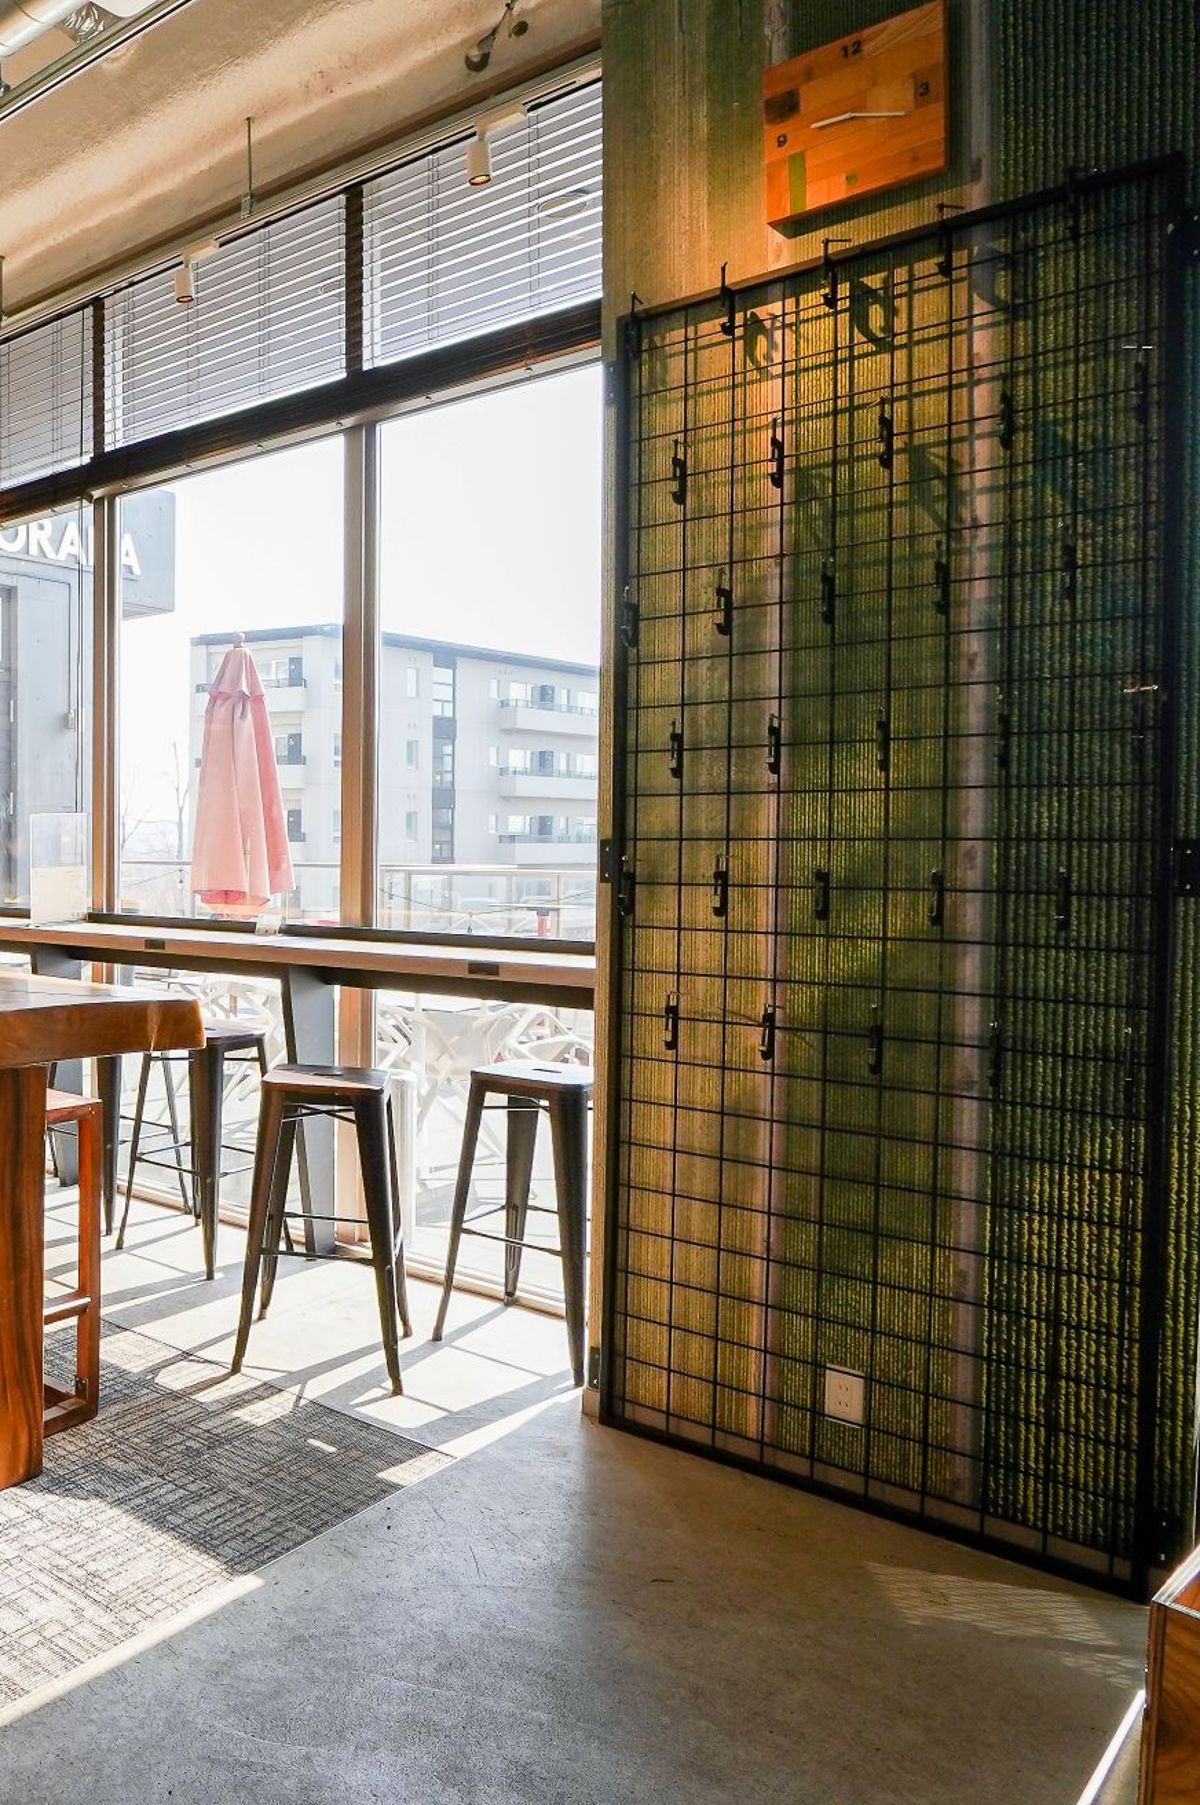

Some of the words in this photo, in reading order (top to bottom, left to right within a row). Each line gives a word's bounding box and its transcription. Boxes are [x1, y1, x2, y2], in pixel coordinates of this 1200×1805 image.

[842, 39, 862, 59] 12
[919, 81, 930, 97] 3
[776, 133, 788, 148] 9
